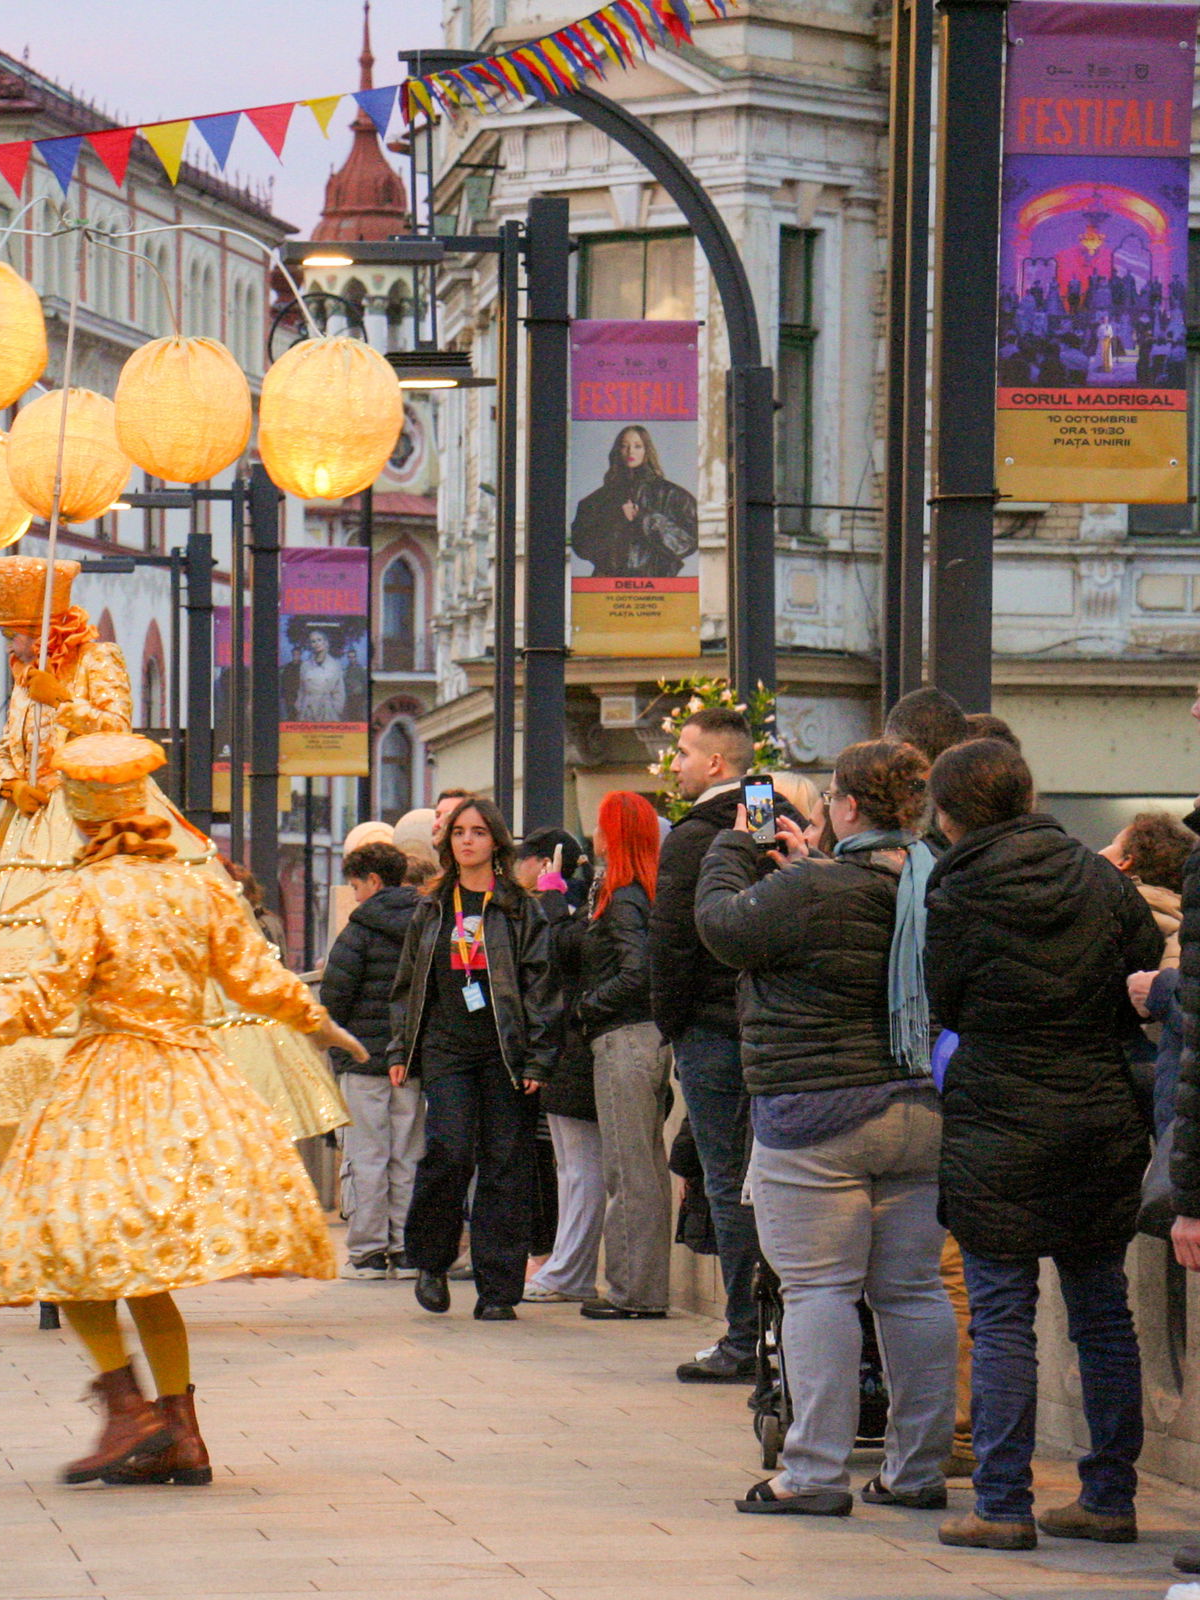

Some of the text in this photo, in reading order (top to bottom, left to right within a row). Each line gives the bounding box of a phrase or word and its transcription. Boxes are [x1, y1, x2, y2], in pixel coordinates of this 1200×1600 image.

[1017, 97, 1181, 147] FESTIFALL
[579, 381, 689, 414] FESTIFALL
[1011, 393, 1174, 406] CORUL MADRIGAL
[1047, 415, 1138, 424] 10 OCTOMBRIE
[1059, 427, 1125, 435] ORA 19:30
[1094, 438, 1131, 447] UNIRII
[615, 580, 655, 589] DELIA
[285, 588, 362, 611] FESTIFALL
